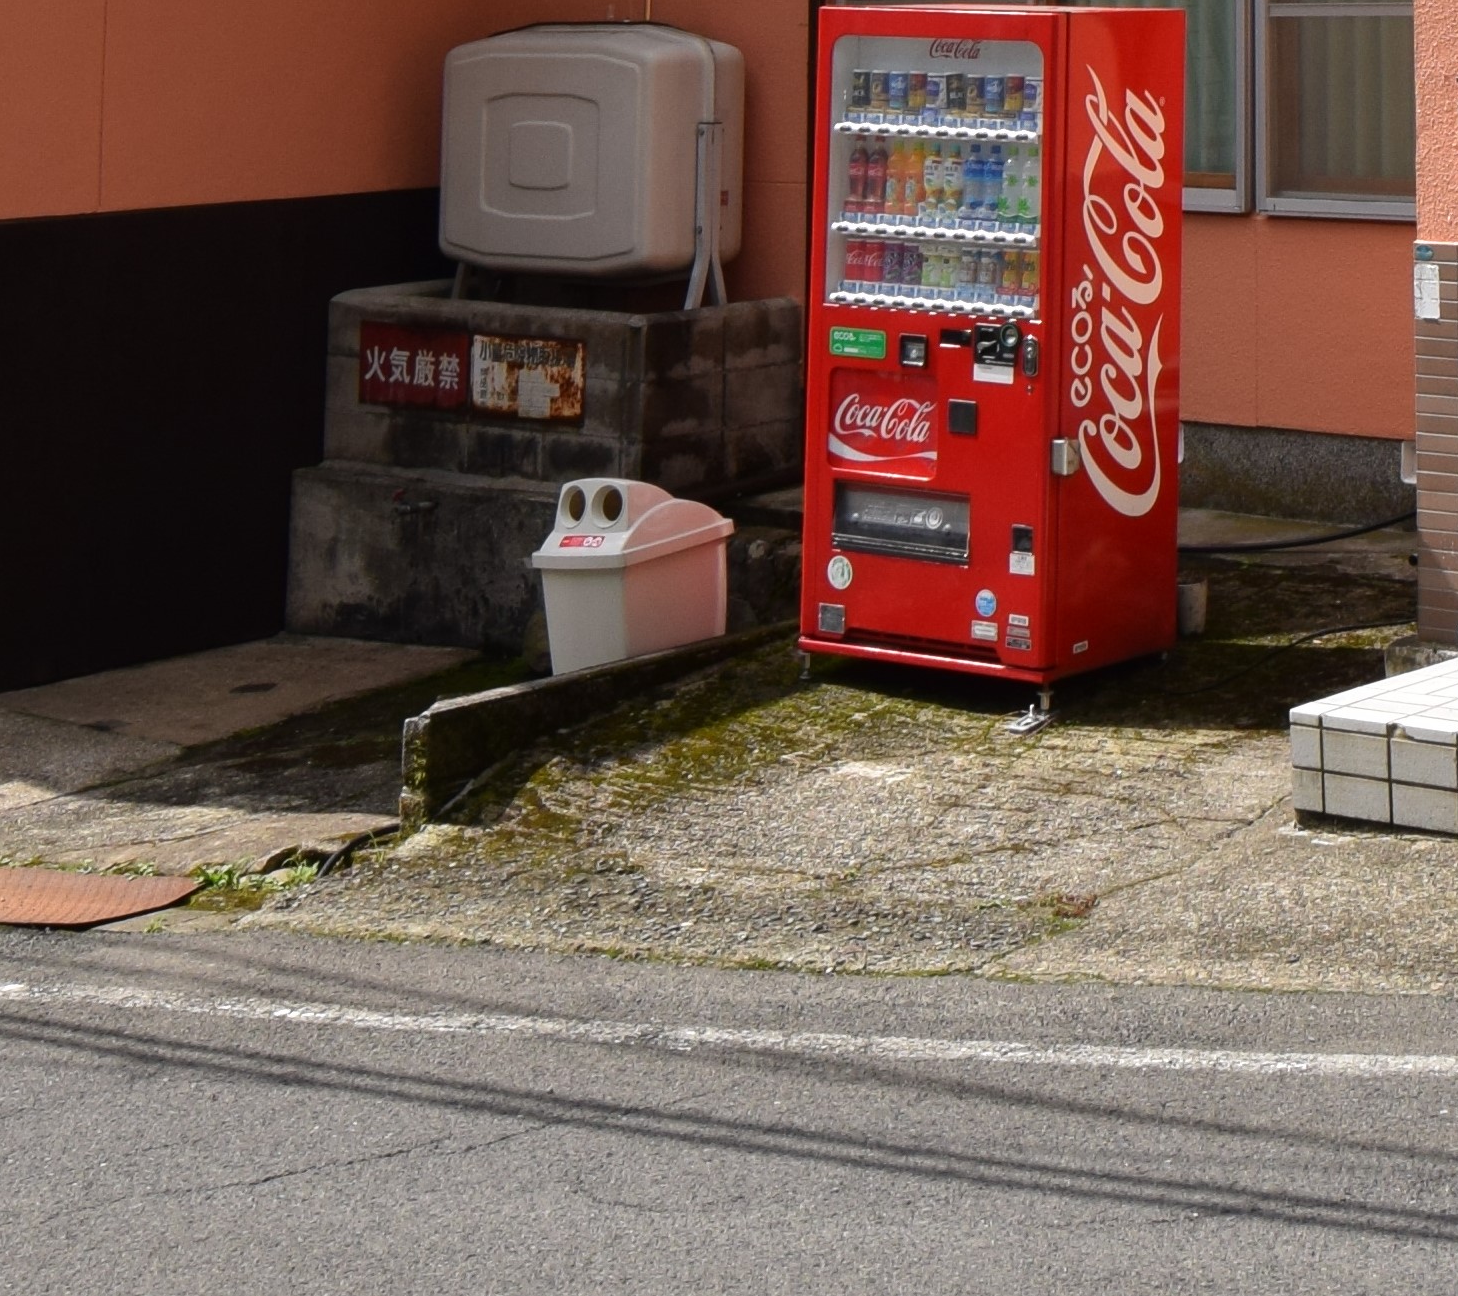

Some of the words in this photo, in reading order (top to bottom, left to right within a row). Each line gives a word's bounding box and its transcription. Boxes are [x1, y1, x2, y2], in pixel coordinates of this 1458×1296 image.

[1078, 63, 1166, 517] Coca-Cola
[364, 345, 460, 390] 火気厳禁
[834, 393, 937, 443] Coca-Cola
